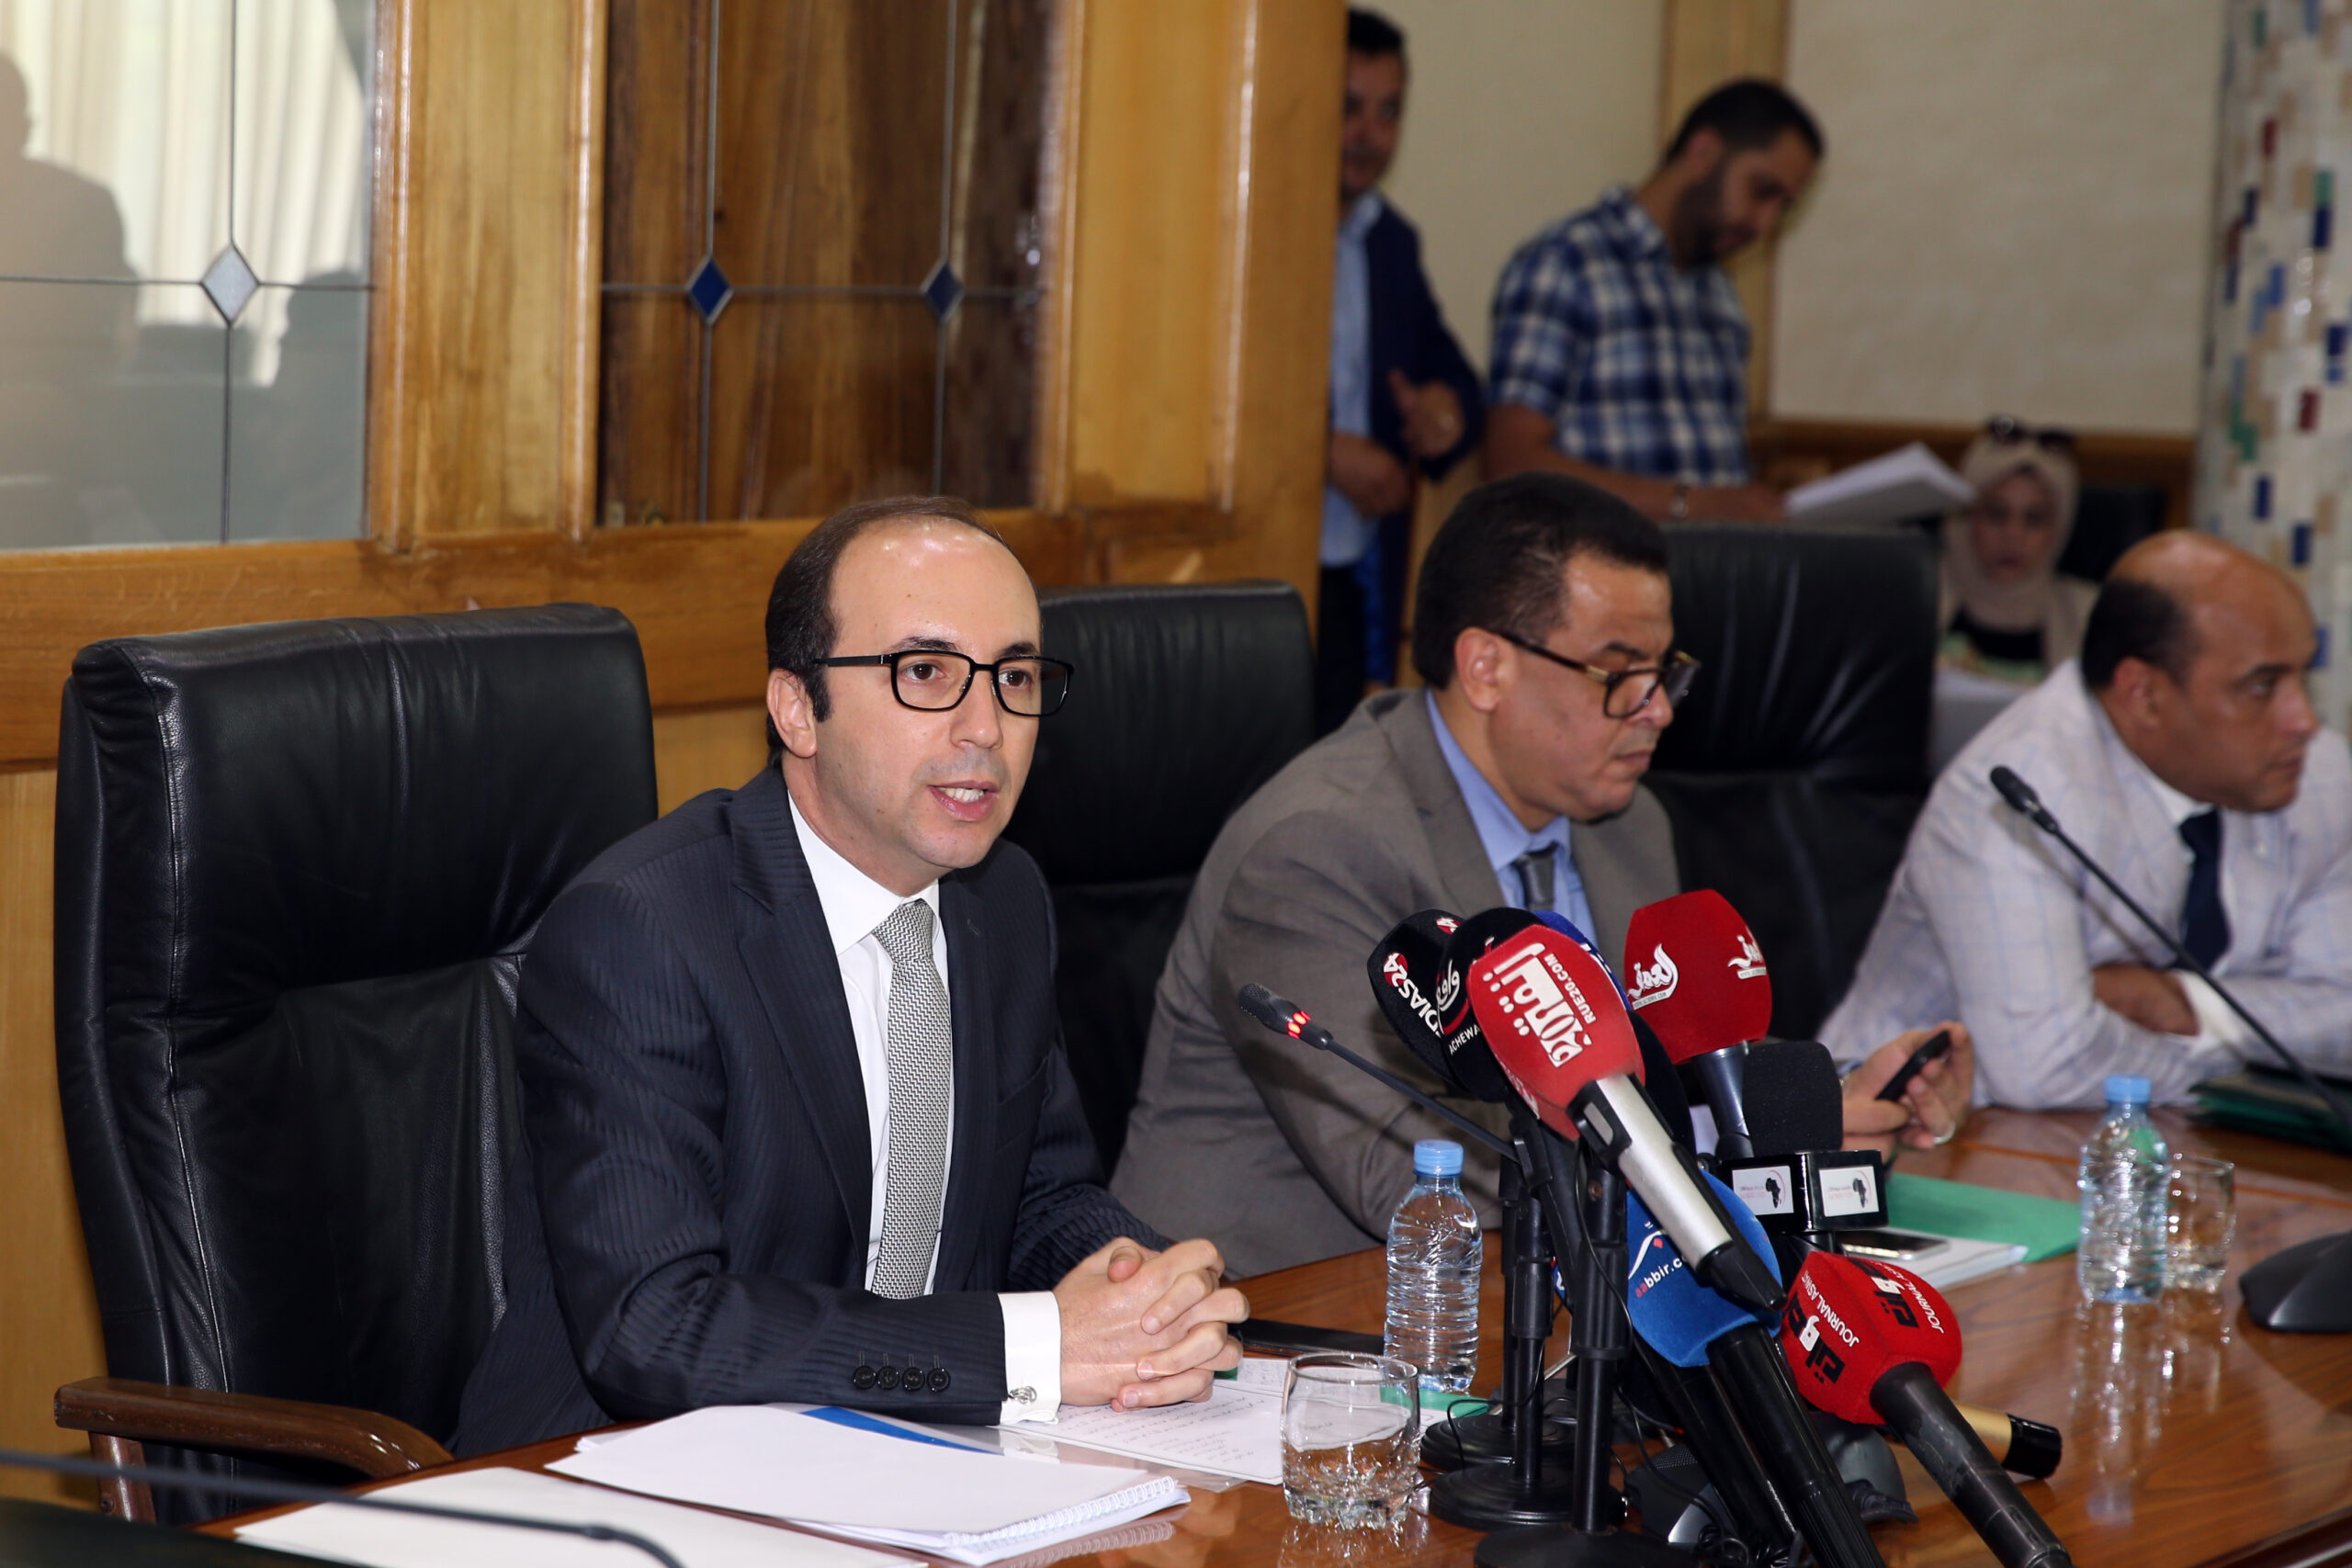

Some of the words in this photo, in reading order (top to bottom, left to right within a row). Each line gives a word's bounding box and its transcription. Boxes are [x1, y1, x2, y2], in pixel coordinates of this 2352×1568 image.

[1384, 953, 1441, 1037] DIAS24
[1544, 953, 1597, 1025] RUE20.COM
[1816, 1296, 1860, 1348] JOURNAL
[1905, 1280, 1944, 1334] JOURNAL
